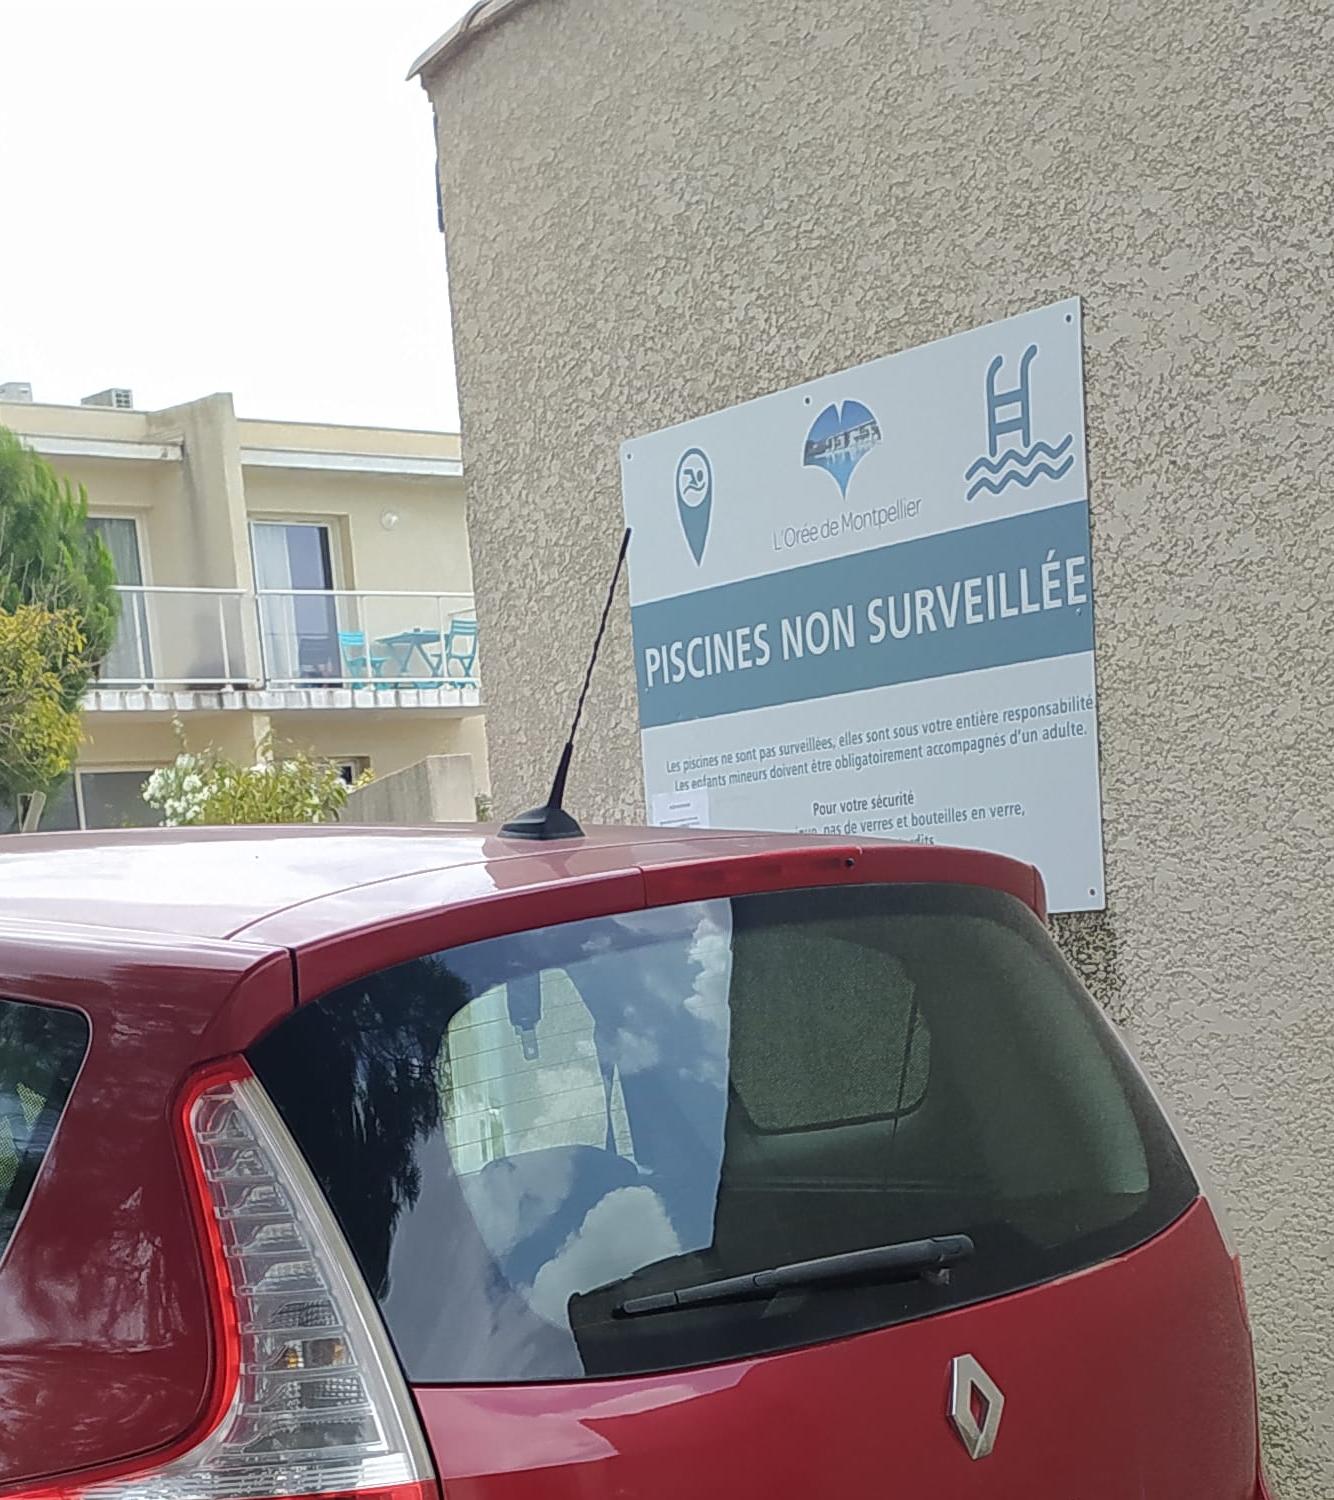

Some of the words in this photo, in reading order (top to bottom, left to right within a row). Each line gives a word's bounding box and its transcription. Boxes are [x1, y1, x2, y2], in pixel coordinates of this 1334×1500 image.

[820, 518, 839, 538] de
[841, 499, 922, 533] Montpellier
[645, 623, 771, 687] PISCINES
[781, 604, 855, 661] NON
[867, 549, 1087, 644] SURVEILLÉE
[667, 760, 681, 773] Les
[683, 754, 719, 773] piscines
[721, 754, 733, 765] ne
[736, 749, 756, 762] sont
[759, 746, 776, 761] pas
[779, 737, 835, 757] surveillées,
[839, 731, 863, 747] elles
[866, 726, 890, 743] sont
[893, 723, 918, 739] sous
[922, 718, 953, 734] votre
[956, 709, 998, 729] entière
[675, 779, 689, 791] Les
[691, 774, 726, 788] enfants
[729, 769, 767, 784] mineurs
[770, 763, 808, 779] doivent
[811, 758, 832, 773] être
[835, 746, 923, 770] obligatoirement
[926, 732, 1006, 755] accompagnés
[1042, 721, 1087, 740] adulte.
[813, 801, 836, 816] Pour
[840, 798, 867, 812] votre
[871, 790, 915, 810] sécurité
[844, 820, 857, 835] de
[861, 817, 893, 833] verres
[897, 814, 908, 829] et
[911, 808, 967, 827] bouteilles
[971, 808, 986, 820] en
[989, 803, 1025, 819] verre,
